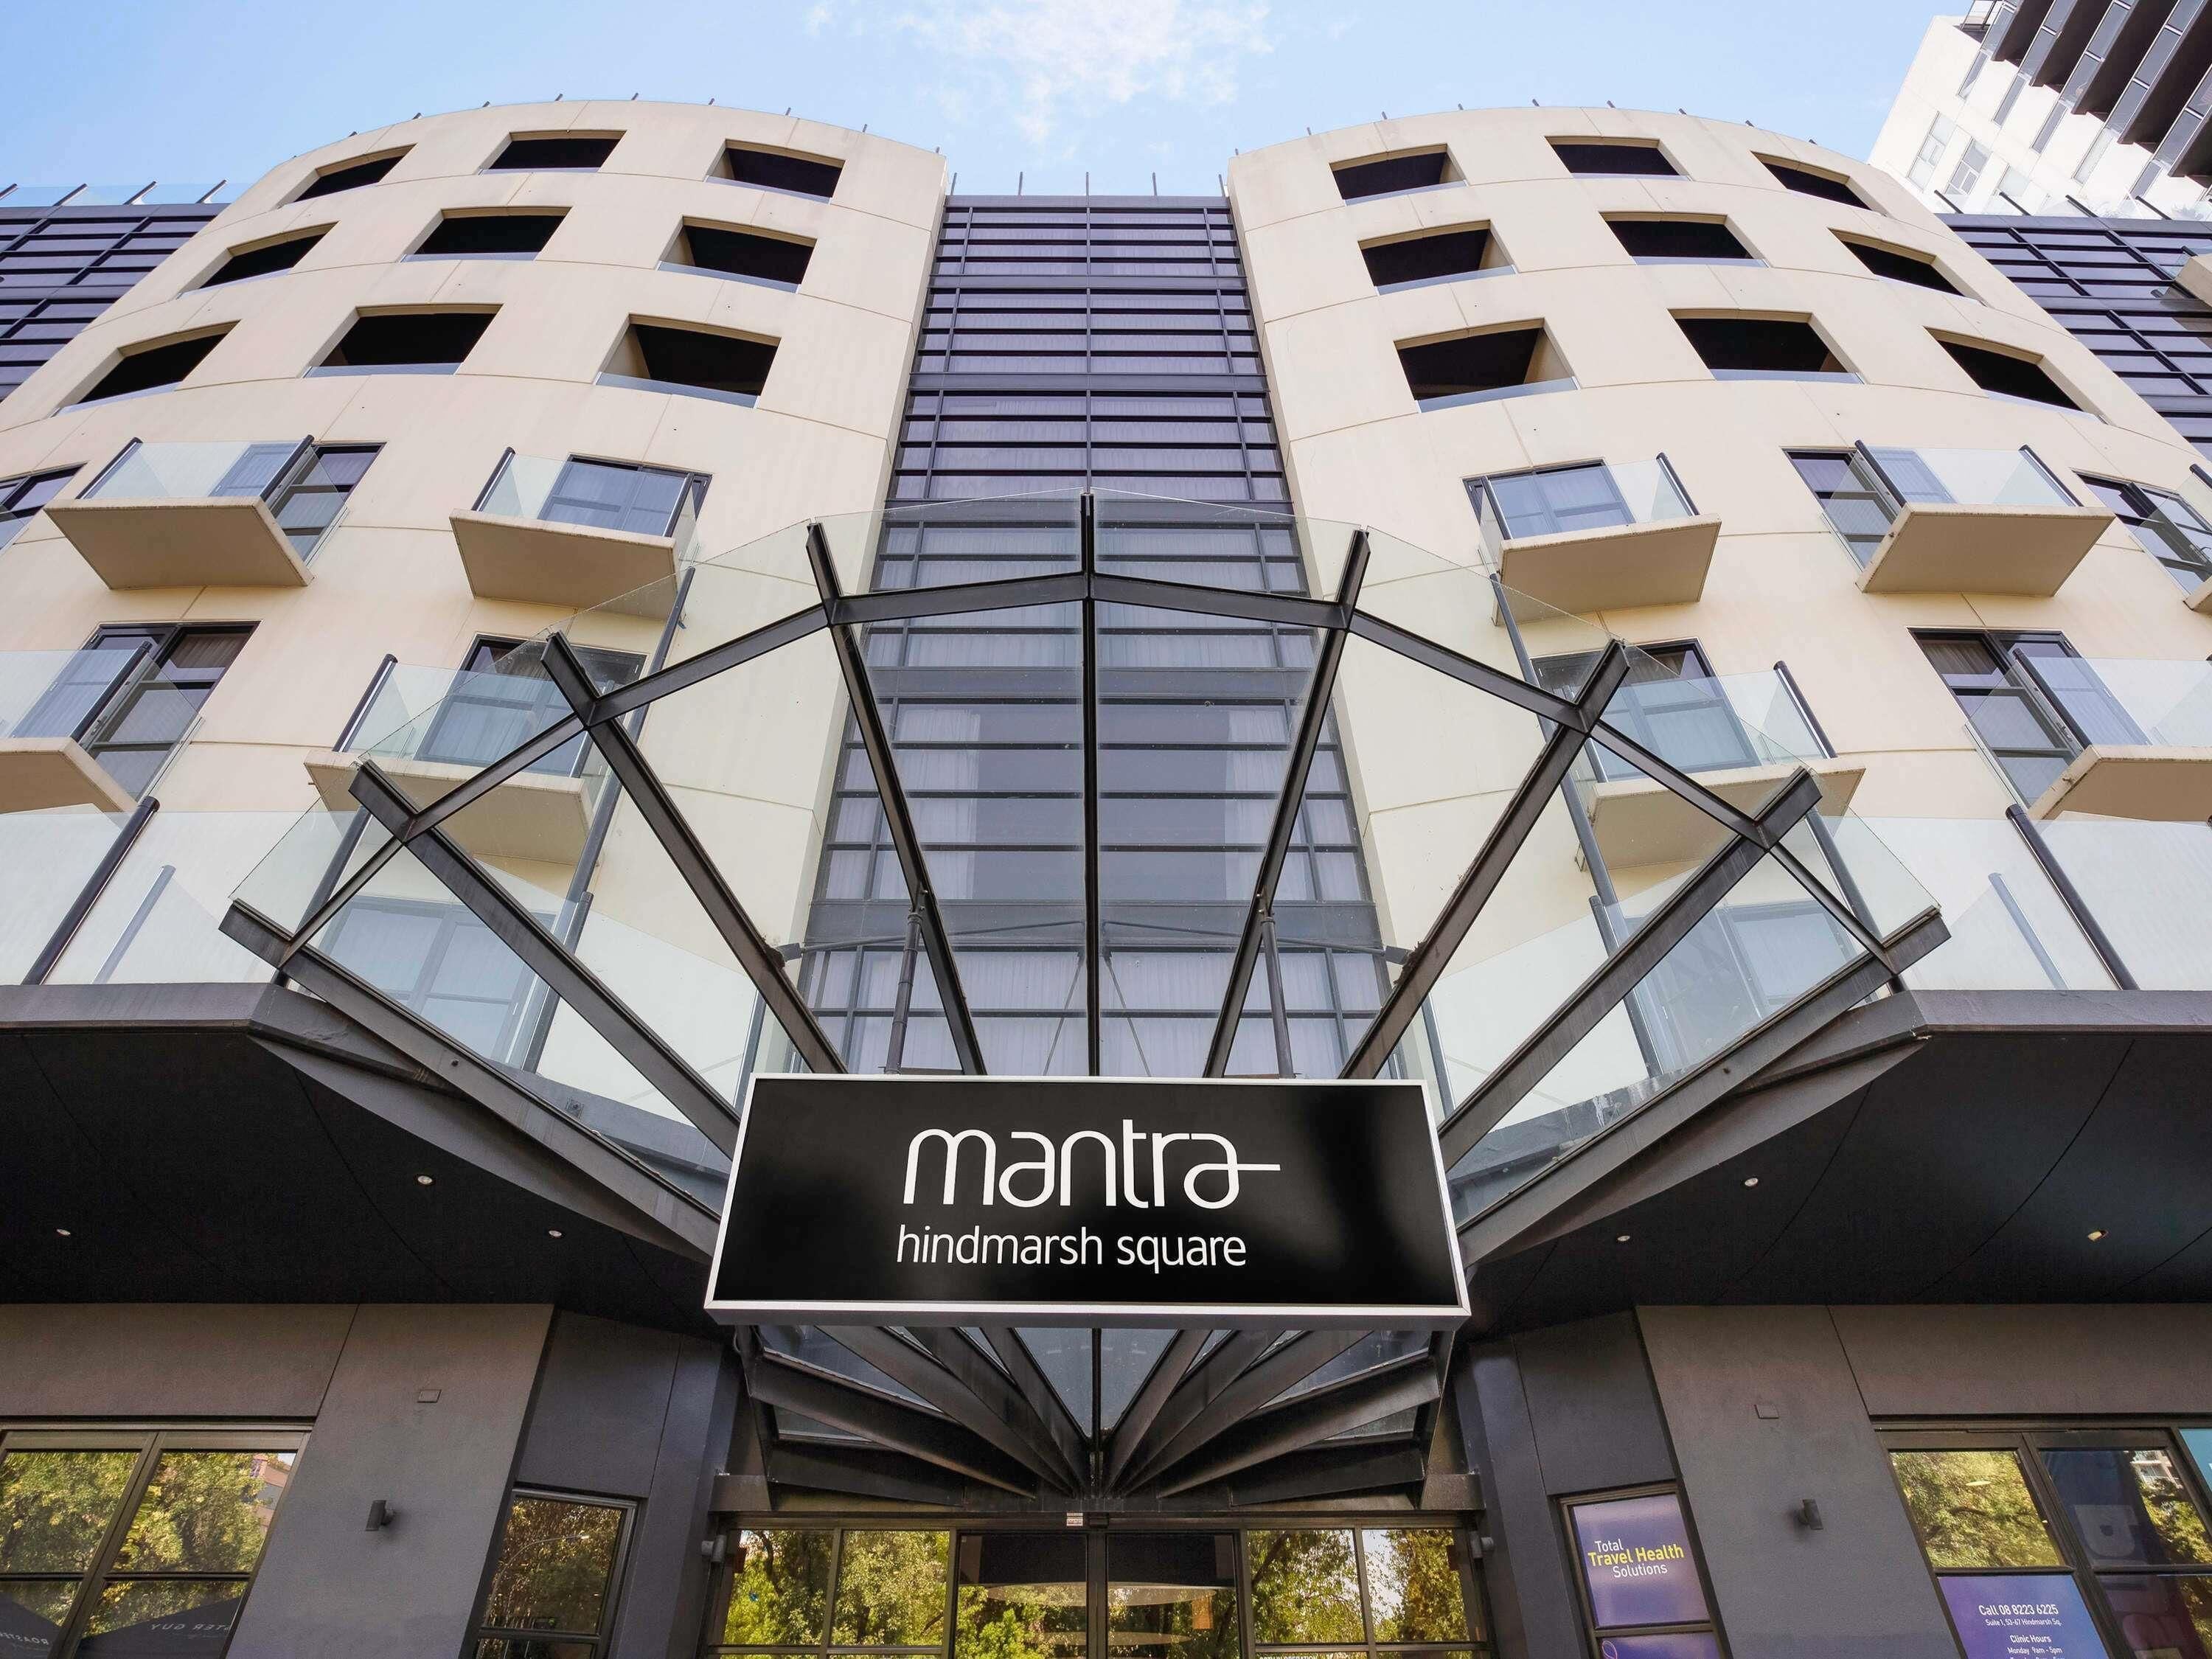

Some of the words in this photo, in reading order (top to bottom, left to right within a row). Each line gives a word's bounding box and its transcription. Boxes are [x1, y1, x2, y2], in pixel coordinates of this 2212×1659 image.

[903, 1119, 1281, 1208] mantra
[897, 1224, 1102, 1265] hindmarsh
[1117, 1236, 1246, 1273] square
[1595, 1539, 1624, 1552] Total
[1587, 1549, 1633, 1566] Travel
[1635, 1544, 1685, 1562] Health
[1613, 1564, 1668, 1578] Solutions
[1978, 1604, 1999, 1615] Call
[1999, 1604, 2011, 1615] 08
[2011, 1604, 2035, 1615] 8223
[2036, 1604, 2059, 1615] 6225
[2009, 1635, 2030, 1643] Clinic
[2030, 1635, 2052, 1643] Hours
[2007, 1647, 2030, 1655] Monday
